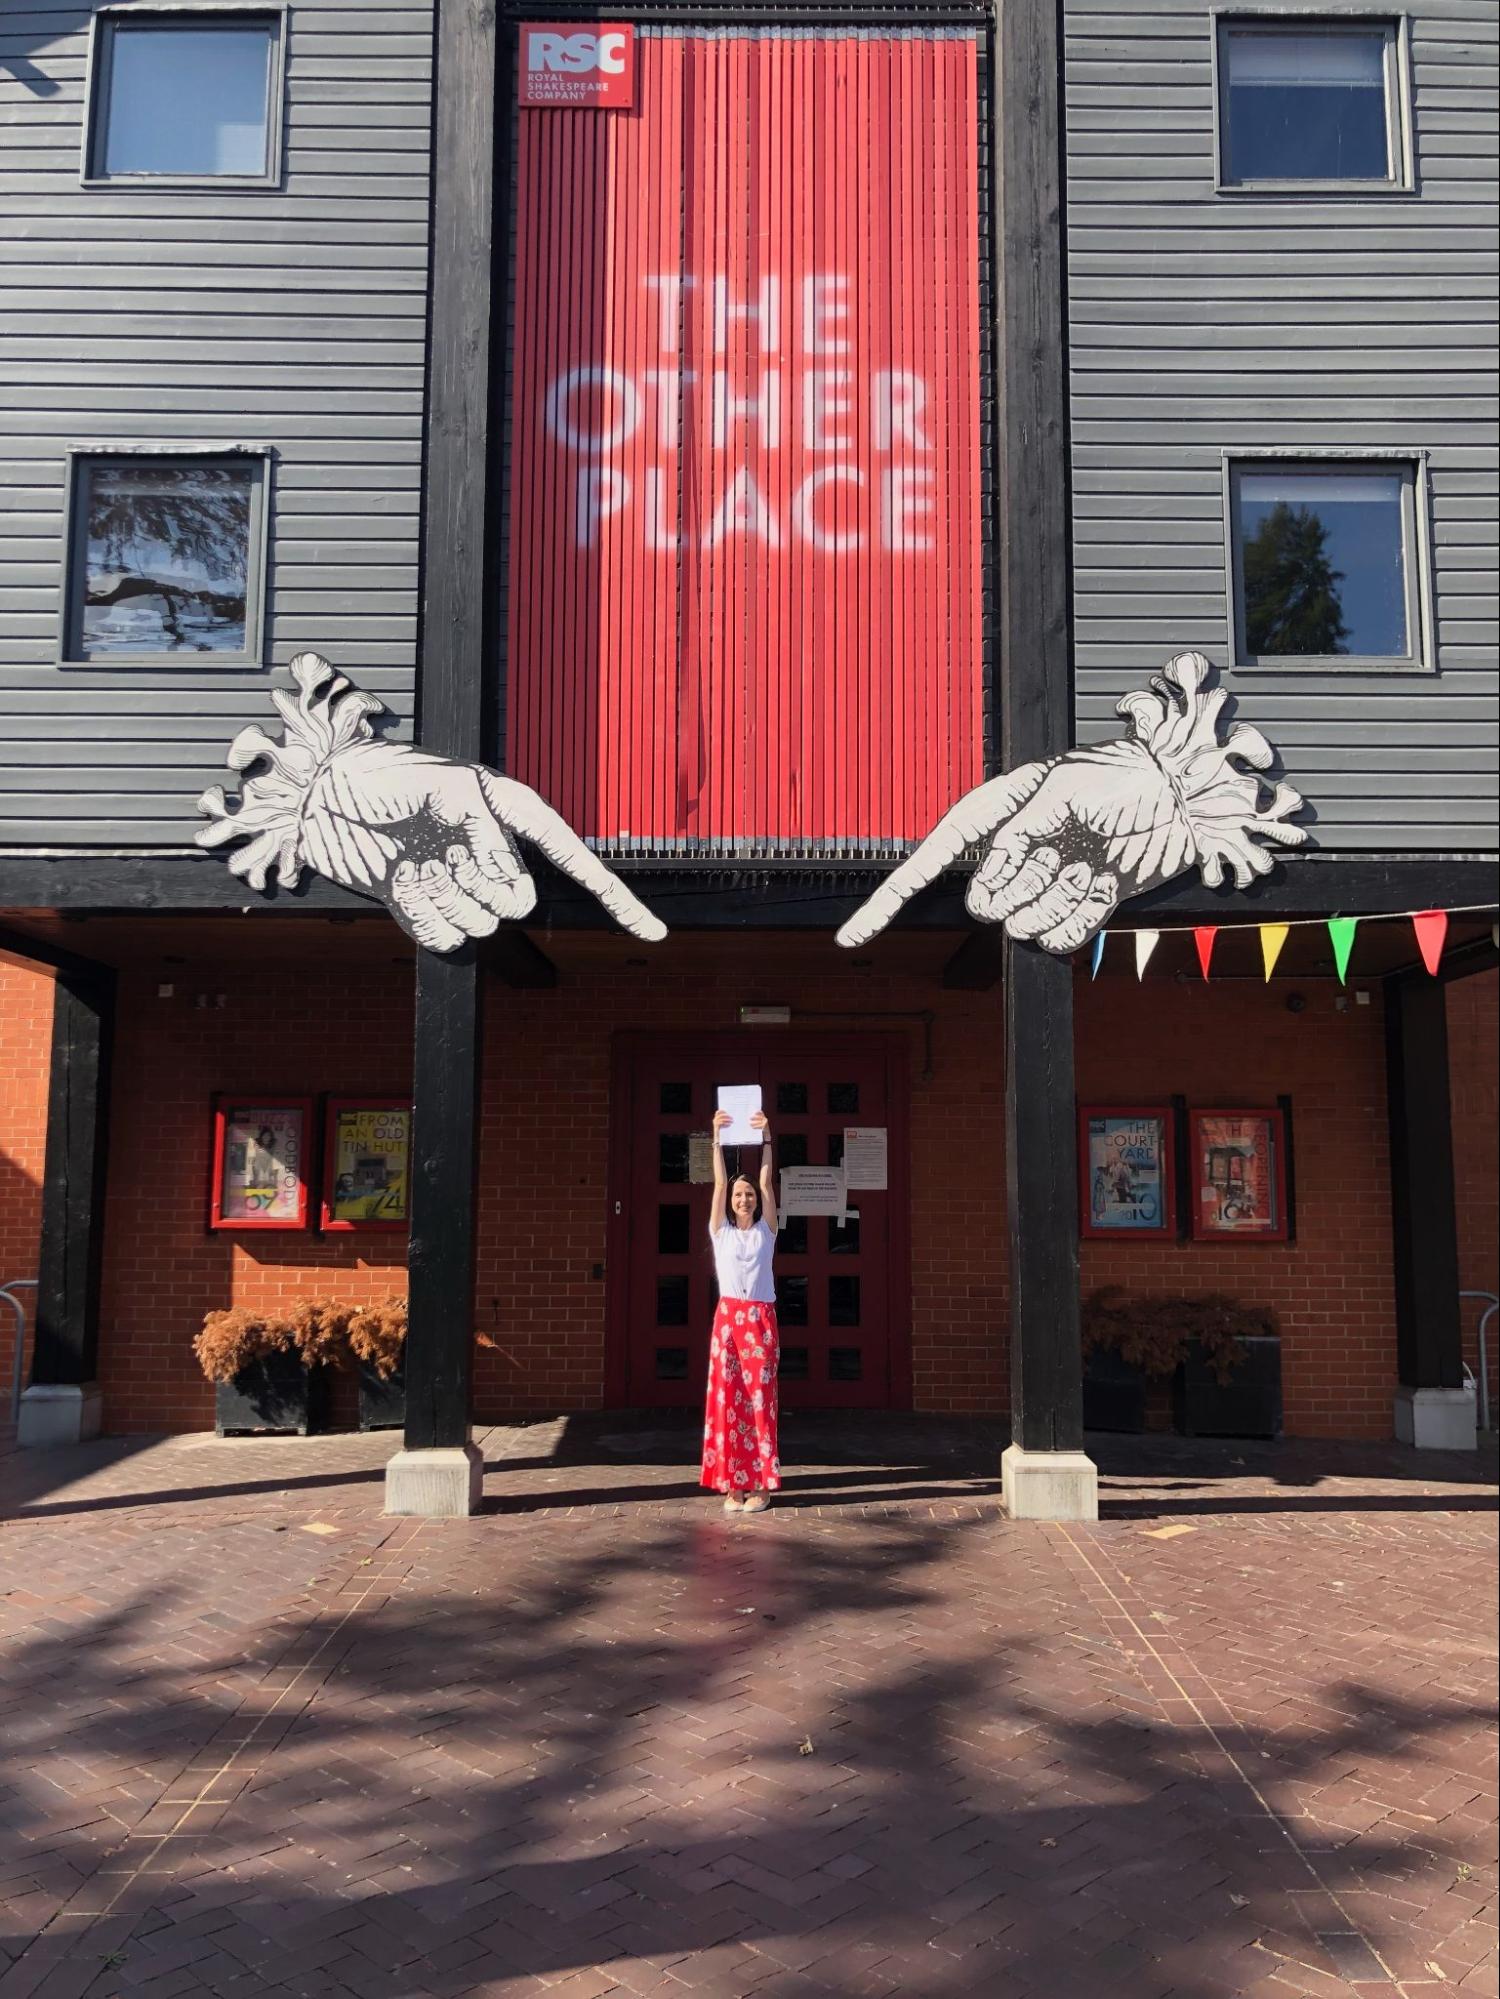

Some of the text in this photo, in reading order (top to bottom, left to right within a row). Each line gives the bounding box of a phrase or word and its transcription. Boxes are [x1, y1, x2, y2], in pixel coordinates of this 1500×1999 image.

[528, 33, 625, 74] RSC
[528, 74, 563, 82] ROYAL
[528, 83, 608, 91] SHAKESPEARE
[528, 91, 586, 100] COMPANY
[644, 275, 852, 354] THE
[545, 366, 934, 452] OTHER
[574, 464, 935, 551] PLACE
[359, 1114, 404, 1127] FROM
[1128, 1120, 1154, 1133] THE
[346, 1127, 404, 1139] AN OLD
[344, 1141, 404, 1153] TIN HUT
[1119, 1147, 1154, 1159] YARD
